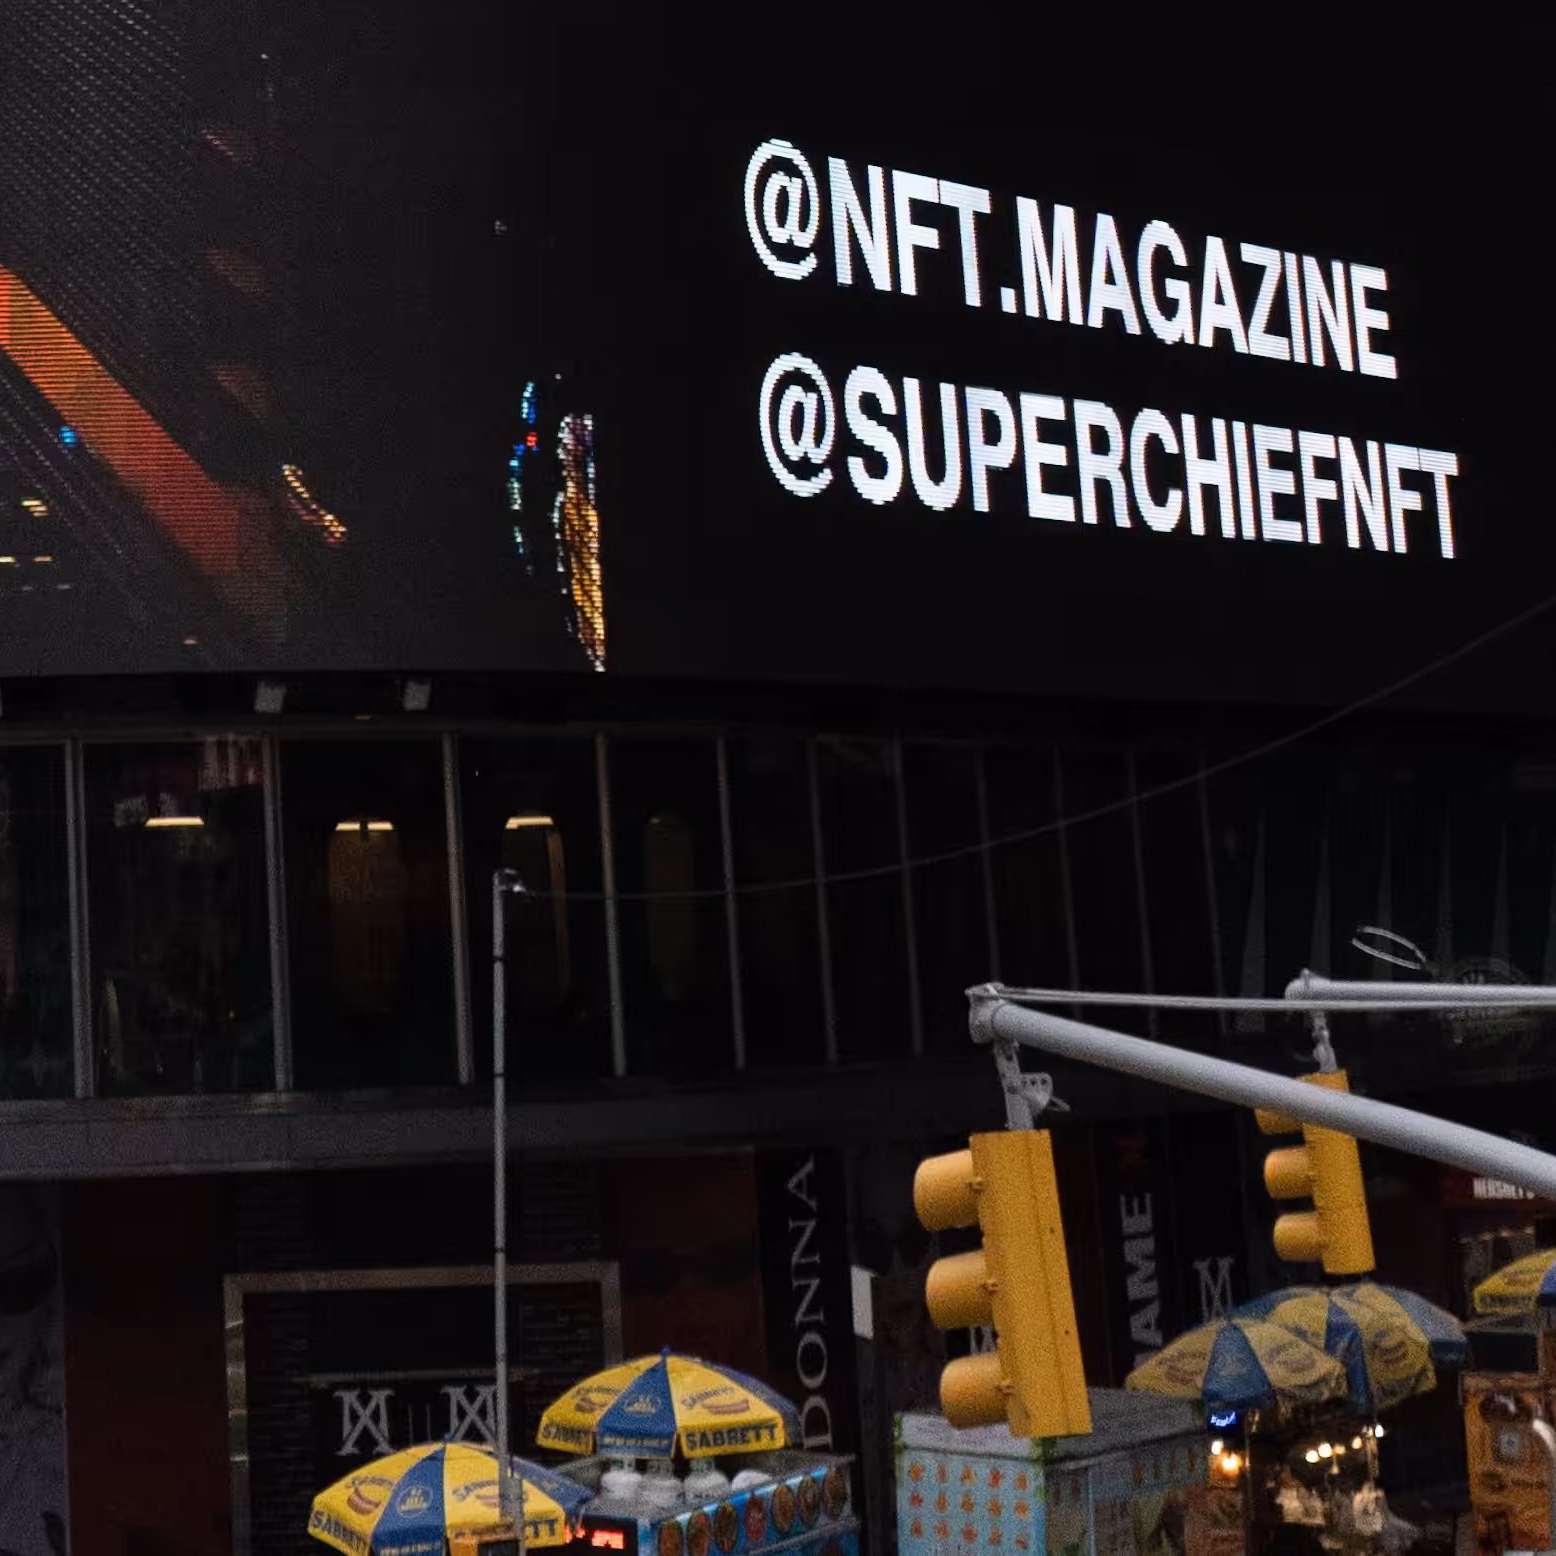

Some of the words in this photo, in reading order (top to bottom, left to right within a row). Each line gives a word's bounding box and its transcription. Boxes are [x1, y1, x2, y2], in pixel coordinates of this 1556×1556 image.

[745, 139, 1397, 379] @NFT.MAGAZINE
[760, 352, 1458, 558] @SUPERCHIEFNFT
[1120, 1192, 1163, 1347] AME
